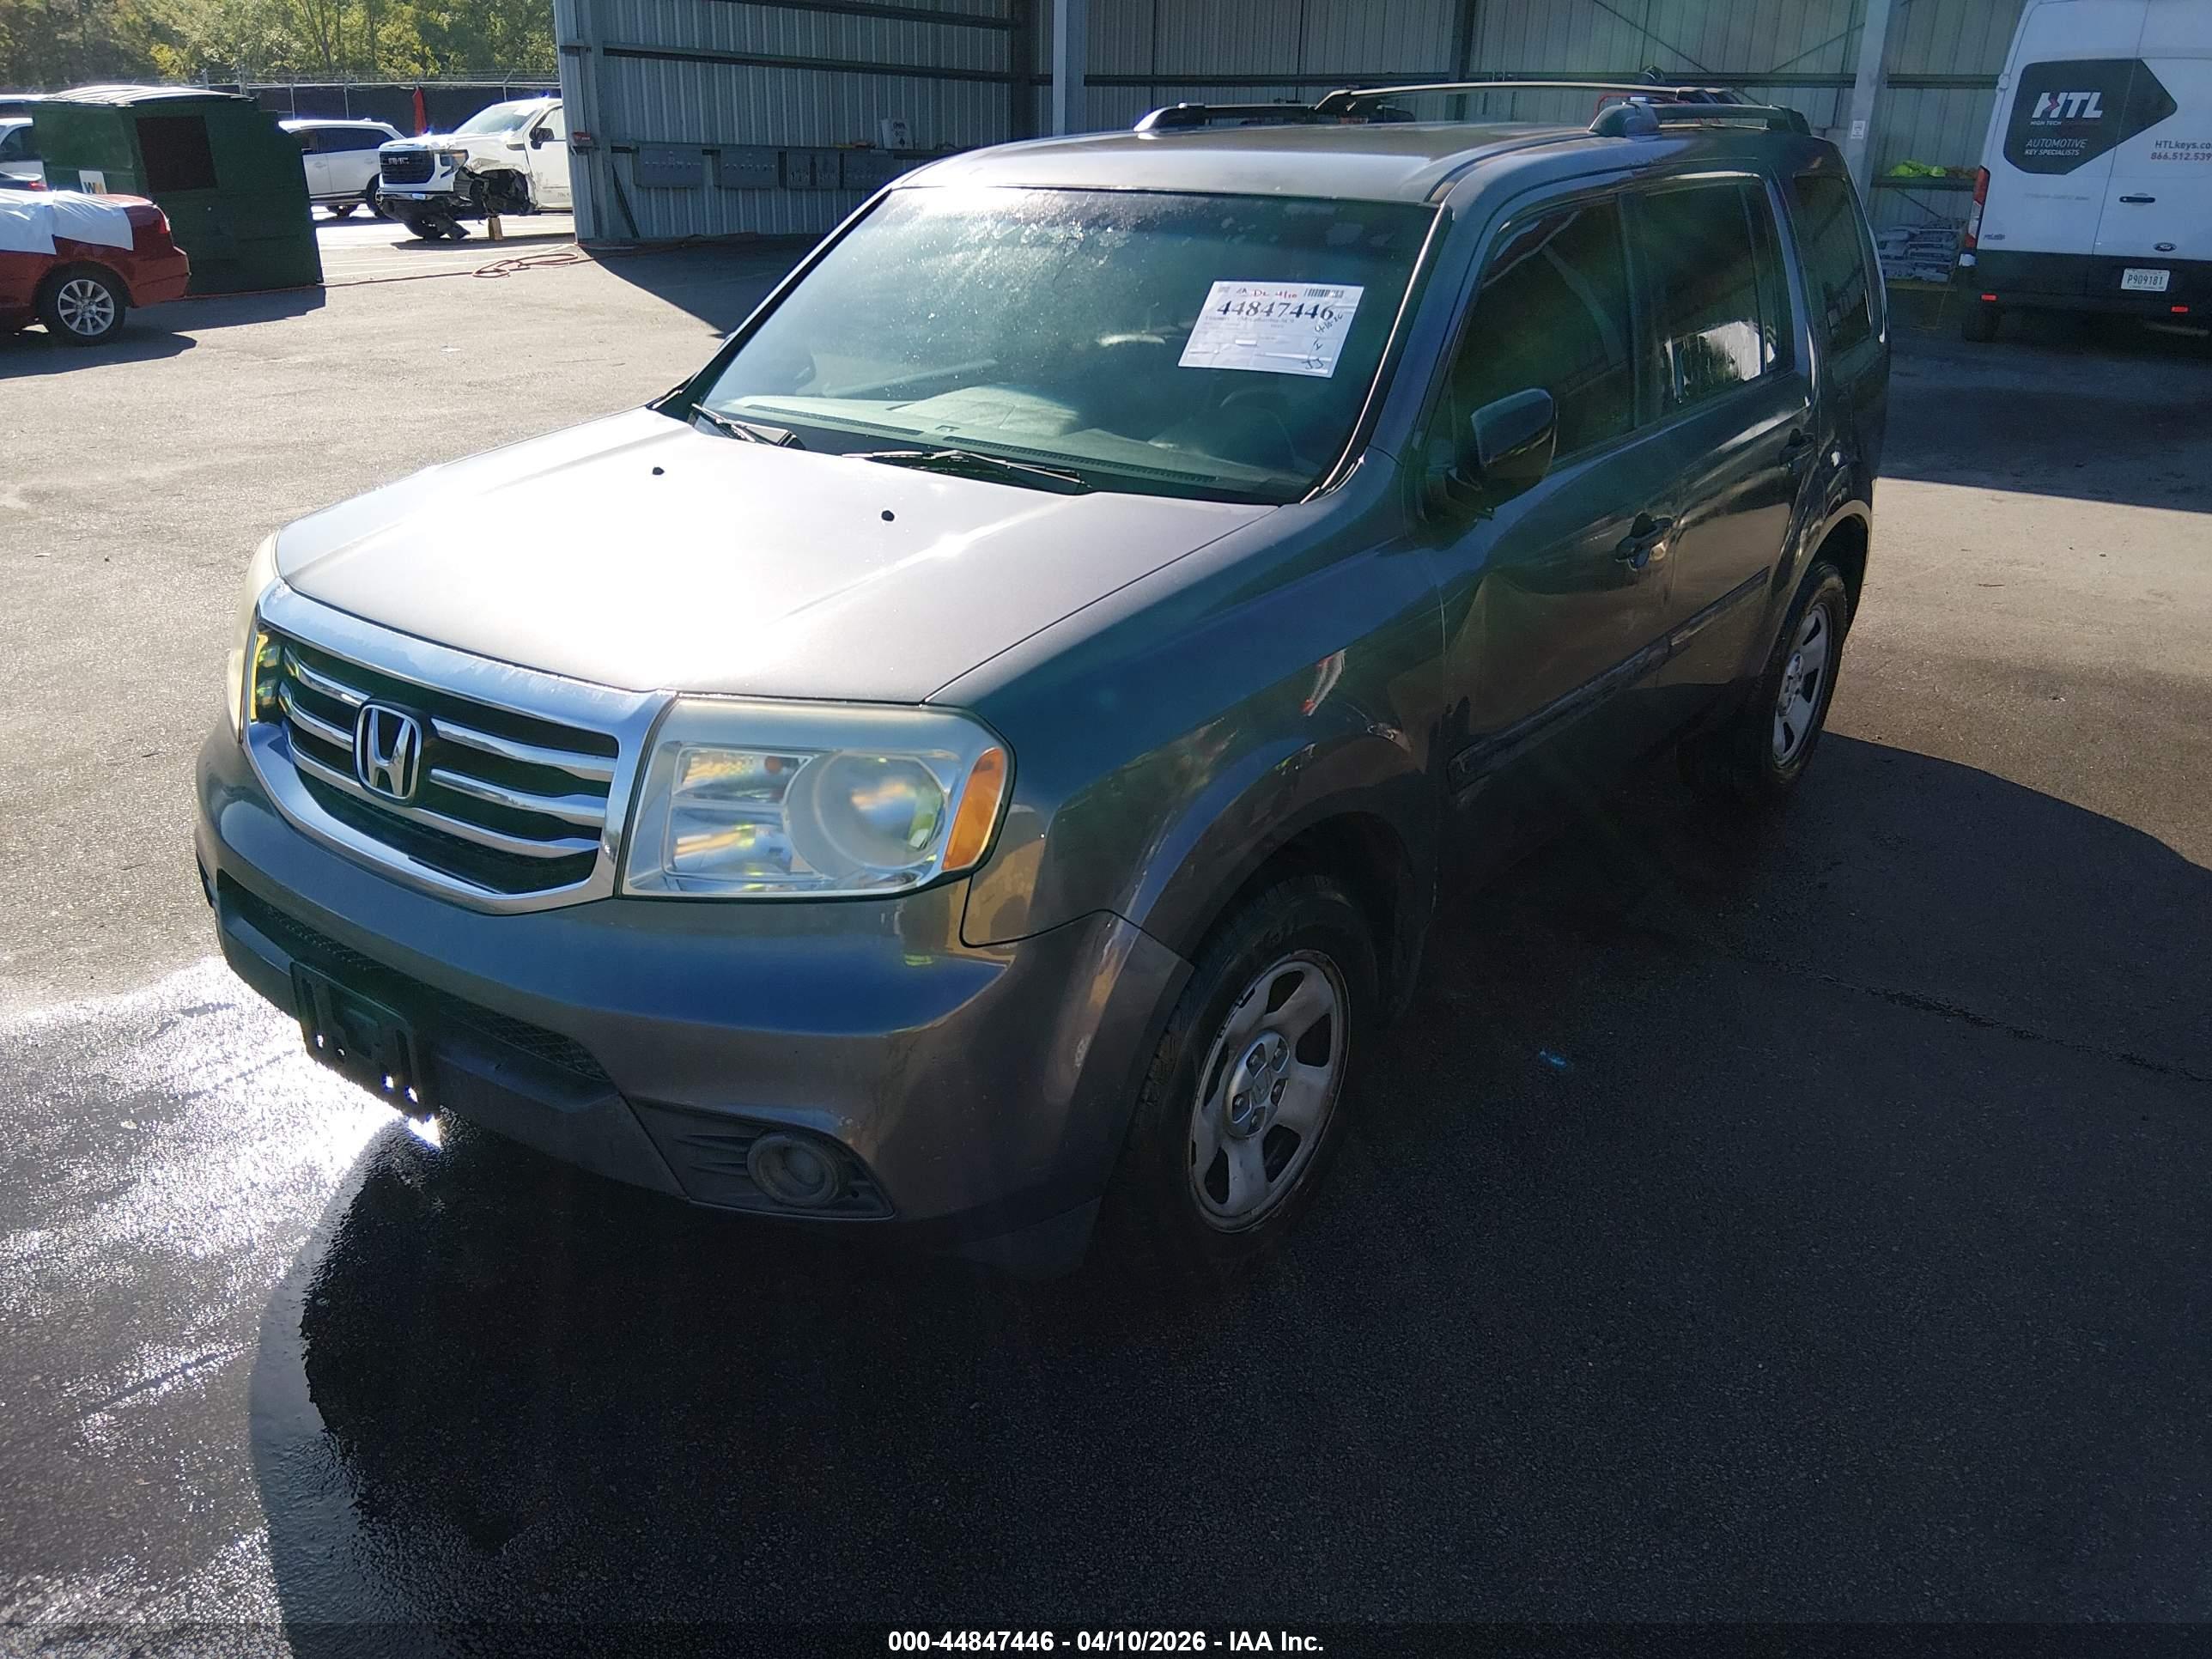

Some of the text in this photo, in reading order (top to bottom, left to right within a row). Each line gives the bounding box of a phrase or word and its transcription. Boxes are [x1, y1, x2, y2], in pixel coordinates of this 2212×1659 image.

[2032, 92, 2103, 118] HTL
[2026, 138, 2088, 149] AUTOMOTIVE
[2155, 140, 2212, 150] HTLkeys.co
[2127, 274, 2163, 286] P909181
[1217, 301, 1334, 321] 44847446
